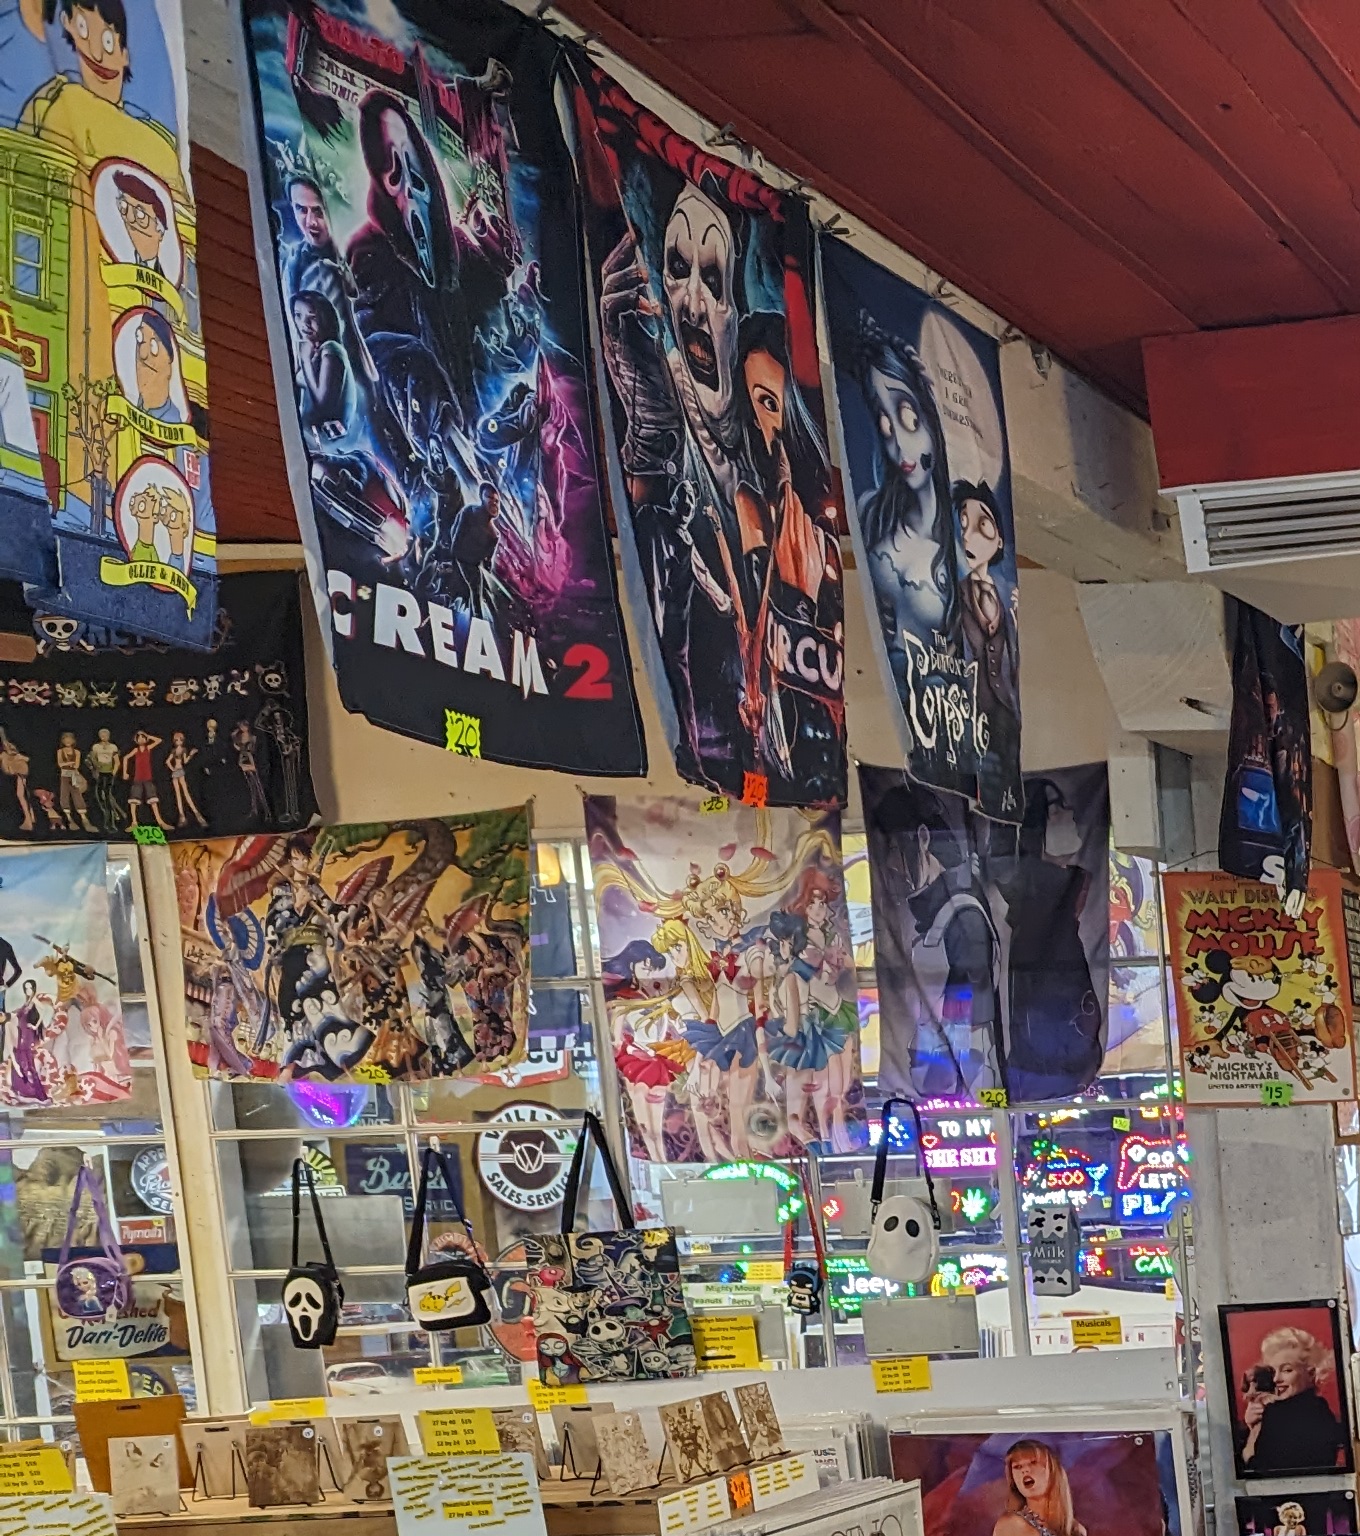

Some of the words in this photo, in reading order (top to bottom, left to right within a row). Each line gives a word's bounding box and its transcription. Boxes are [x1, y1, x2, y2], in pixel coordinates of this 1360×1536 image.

[136, 266, 165, 294] MORT
[157, 423, 186, 442] TEDDY
[170, 572, 190, 595] ANDY
[563, 643, 613, 699] 2
[1188, 889, 1237, 905] WALT
[1186, 930, 1325, 960] MOUSE
[1209, 1071, 1280, 1081] NIGHTMARE
[1217, 1062, 1273, 1072] MICKEY'S
[937, 1119, 961, 1137] TO
[1033, 1246, 1066, 1259] Milk
[705, 1284, 733, 1294] Mighty
[734, 1284, 761, 1292] Mouse
[841, 1275, 899, 1296] Jeep
[1076, 1319, 1111, 1328] Musicals
